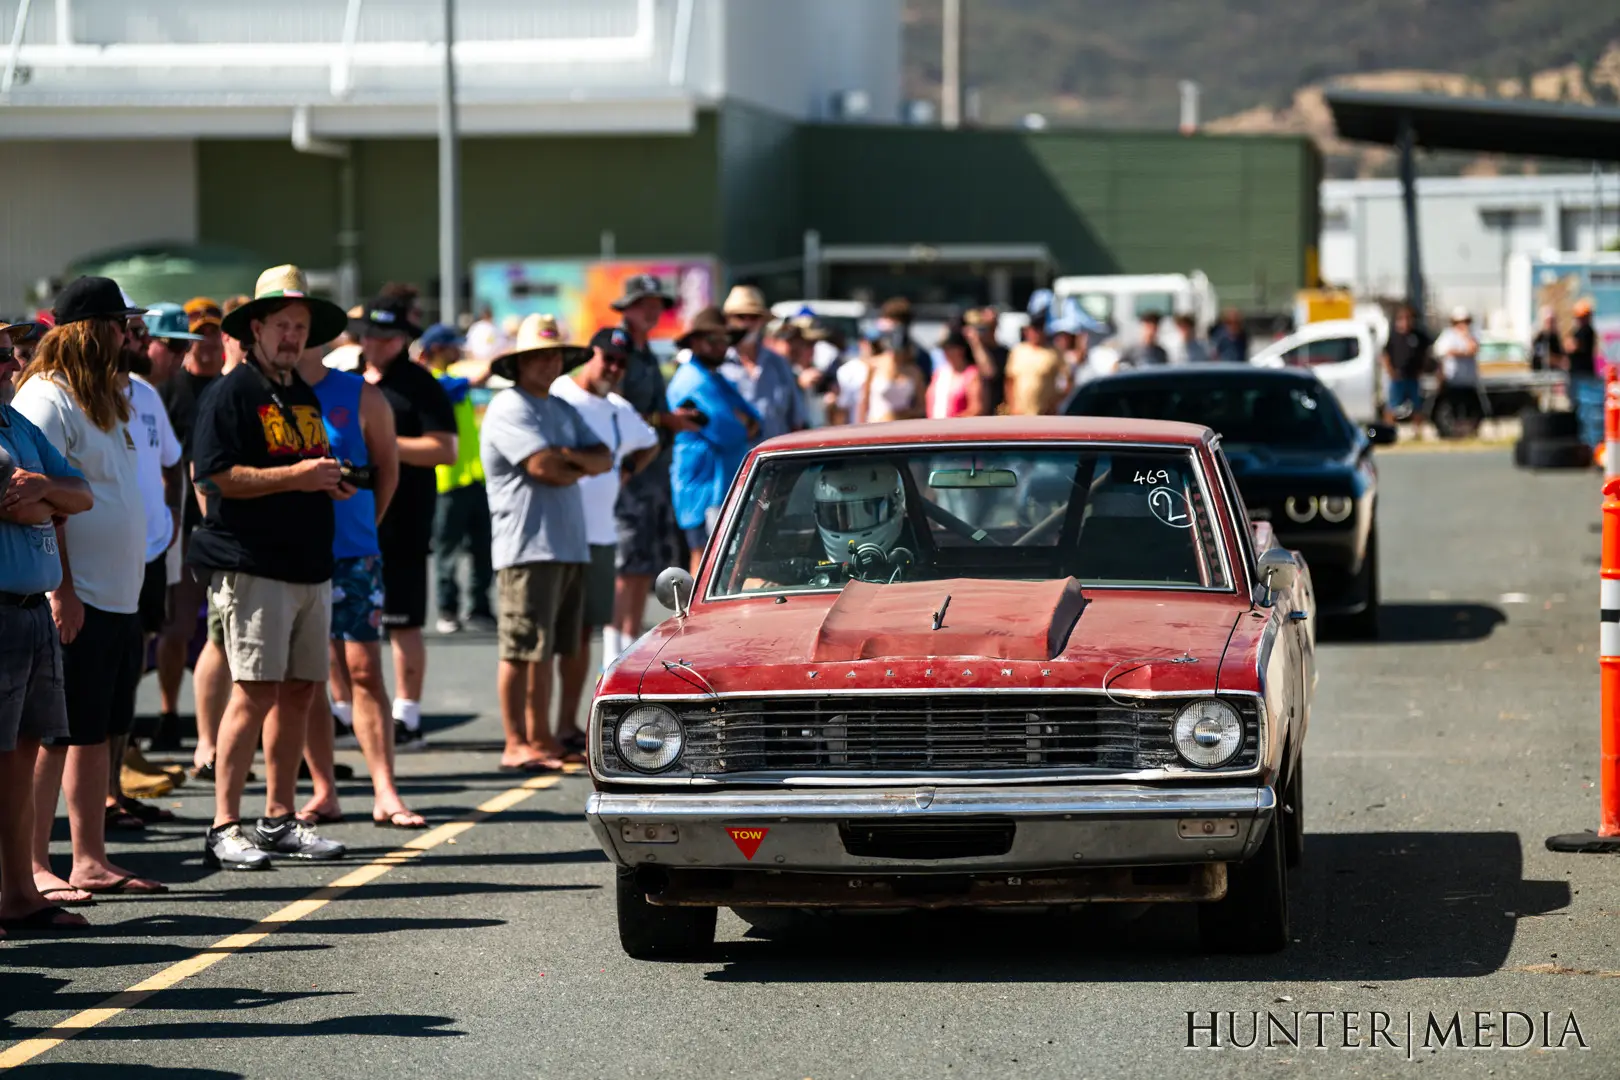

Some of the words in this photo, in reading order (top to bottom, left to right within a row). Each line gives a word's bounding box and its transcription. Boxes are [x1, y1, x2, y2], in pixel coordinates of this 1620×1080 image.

[1133, 469, 1170, 485] 469
[1152, 490, 1187, 522] 2
[806, 668, 1053, 680] VALIANT
[731, 830, 763, 840] TOW
